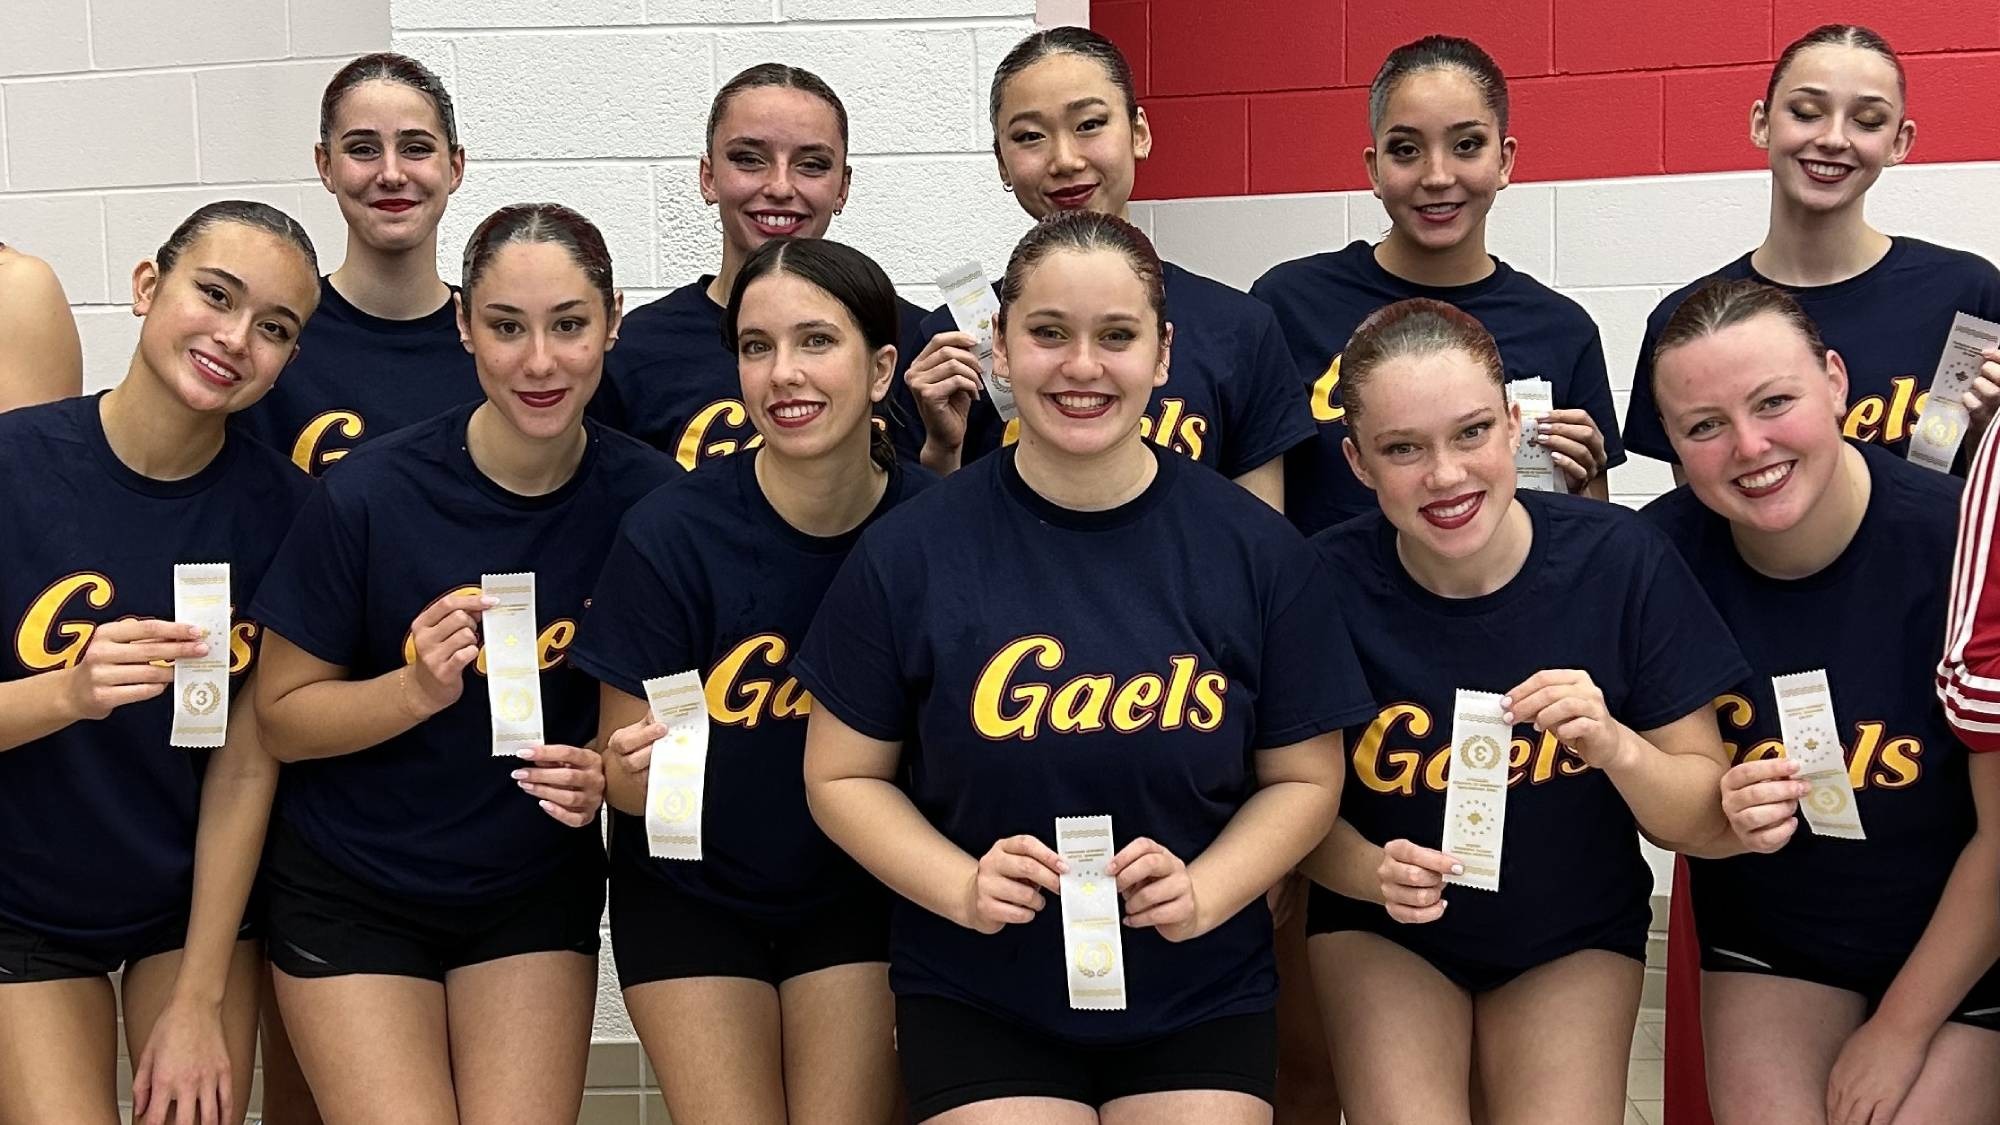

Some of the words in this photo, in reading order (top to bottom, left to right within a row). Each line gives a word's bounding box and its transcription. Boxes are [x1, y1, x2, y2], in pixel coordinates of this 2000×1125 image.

[971, 634, 1228, 741] Gaels
[196, 690, 208, 706] 3
[1473, 745, 1487, 762] 3
